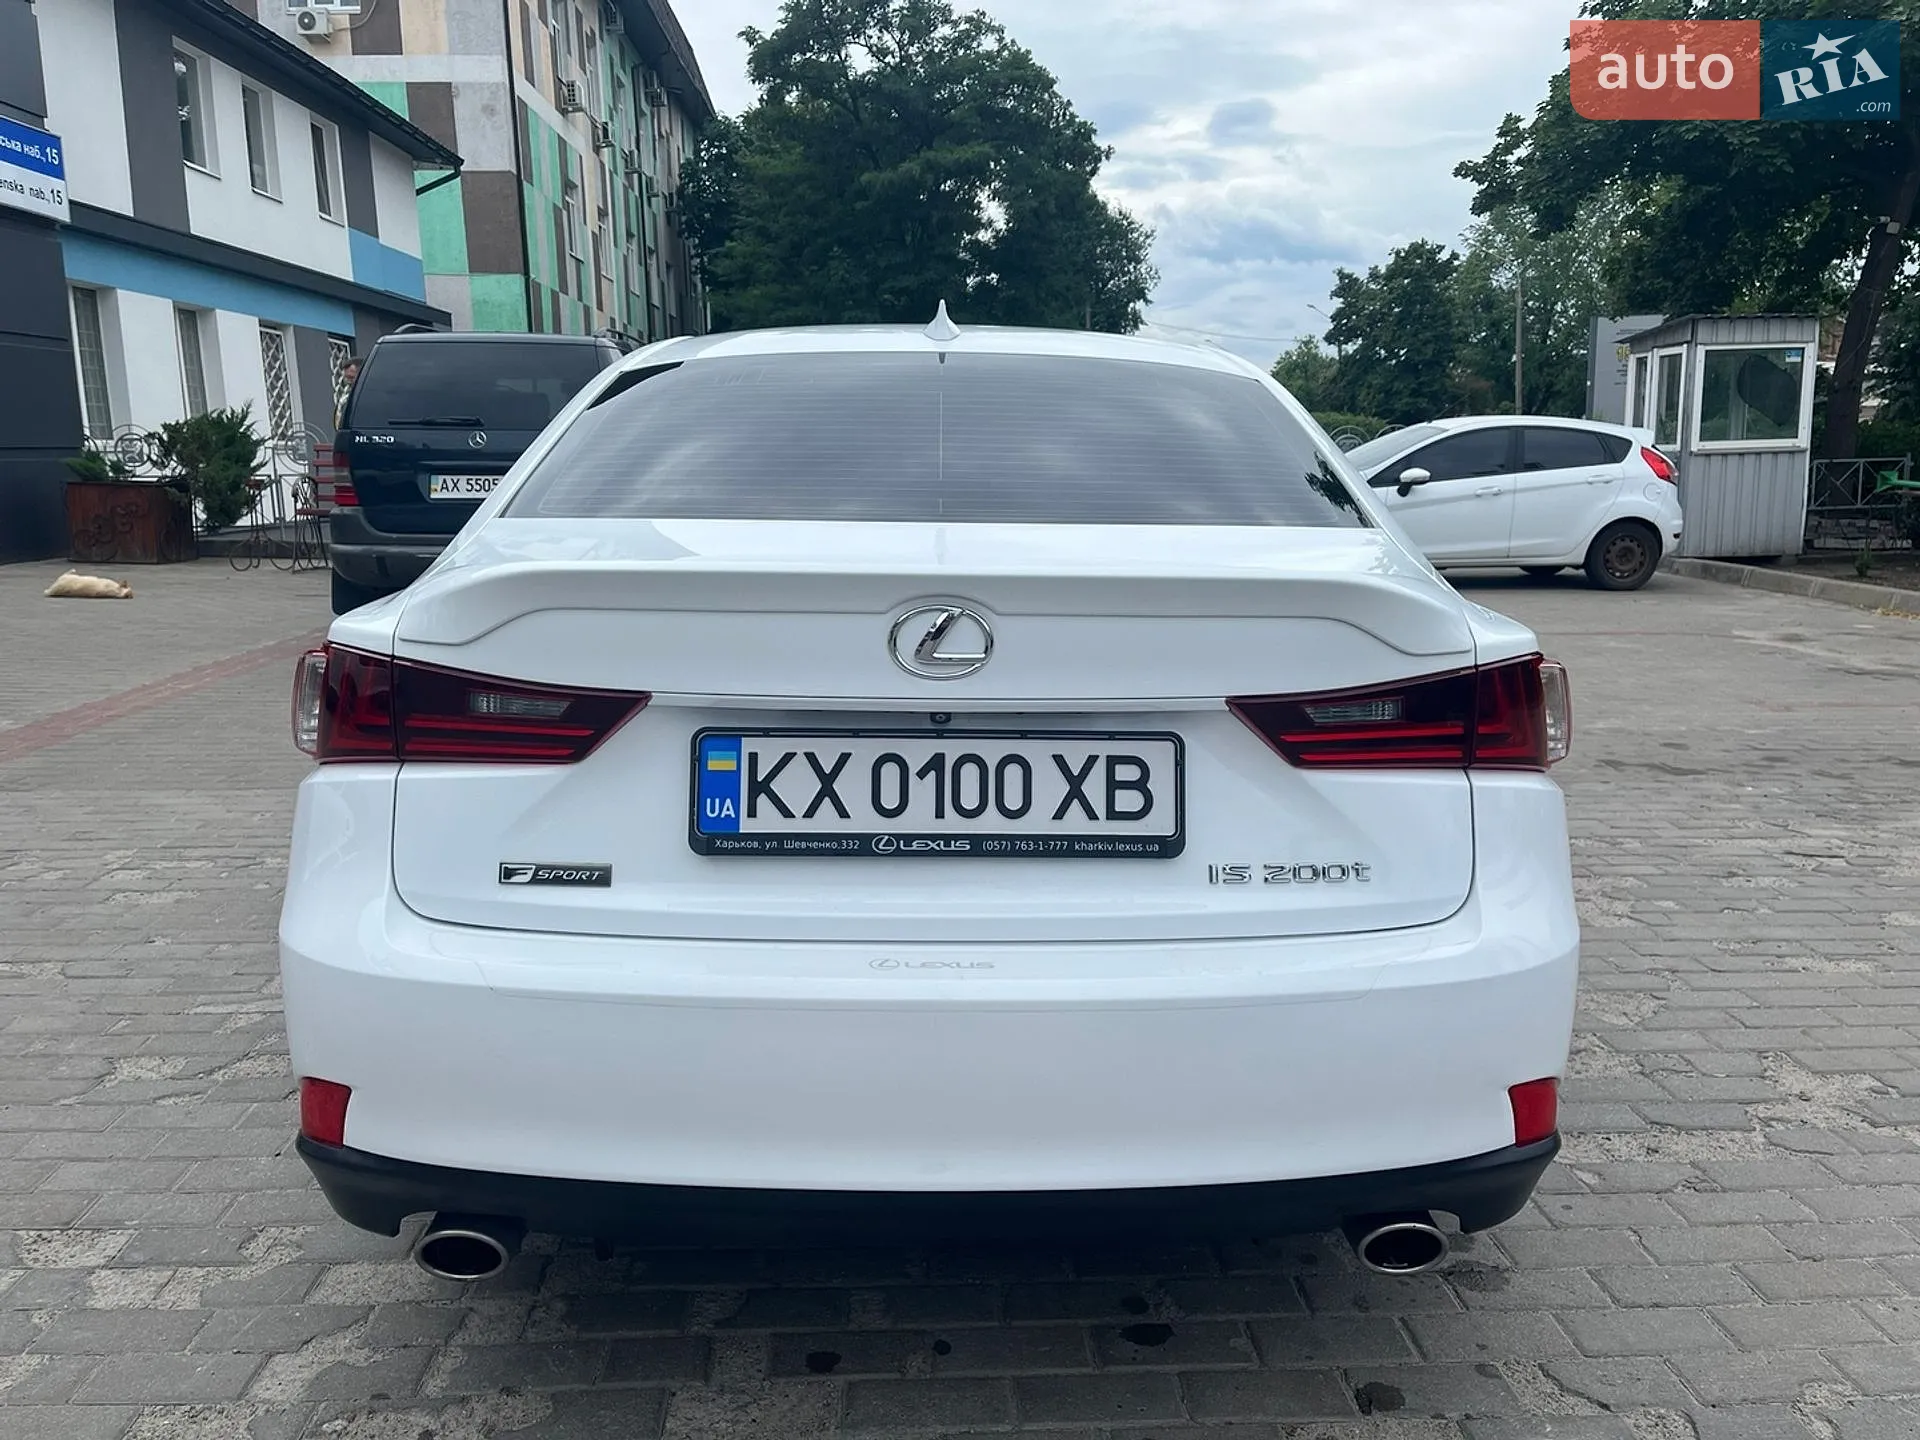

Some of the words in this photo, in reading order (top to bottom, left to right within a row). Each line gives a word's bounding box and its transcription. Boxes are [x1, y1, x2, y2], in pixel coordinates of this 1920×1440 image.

[440, 478, 461, 493] AX
[746, 751, 853, 819] KX
[871, 752, 1032, 820] 0100
[1051, 754, 1155, 821] XB
[705, 797, 736, 818] UA
[899, 840, 971, 851] LEXUS
[982, 841, 1011, 851] (057)
[1014, 841, 1069, 850] 763-1-777
[1074, 841, 1160, 851] kharkiv.lexus.ua
[536, 869, 605, 881] SPORT
[1208, 863, 1252, 885] IS
[1263, 861, 1371, 885] 200t
[904, 961, 996, 970] LEXUS
